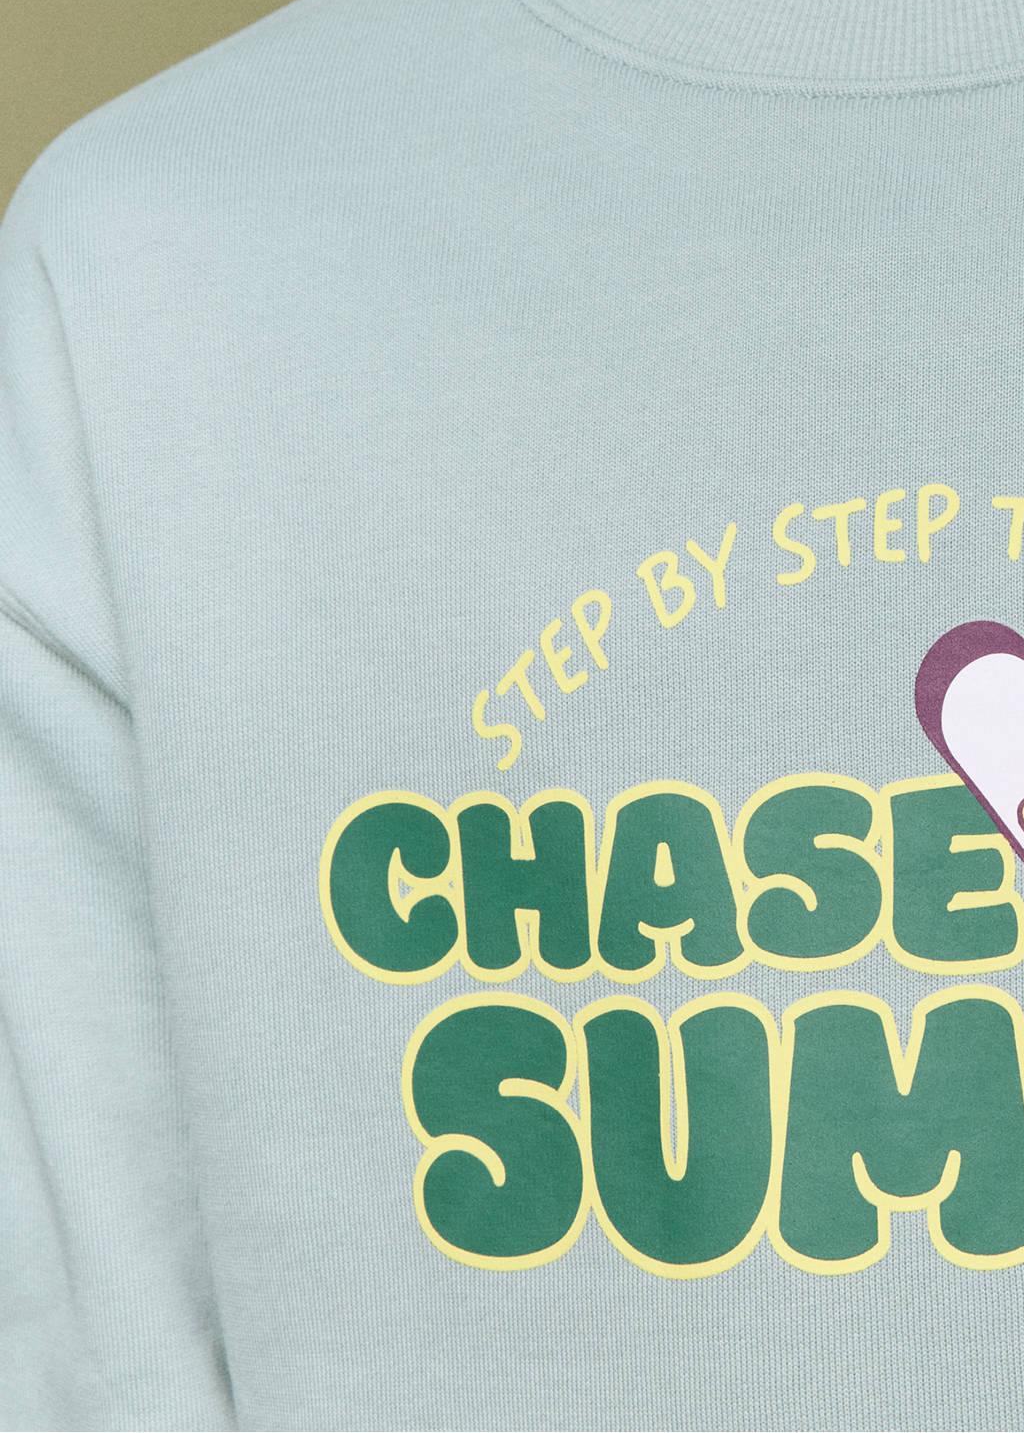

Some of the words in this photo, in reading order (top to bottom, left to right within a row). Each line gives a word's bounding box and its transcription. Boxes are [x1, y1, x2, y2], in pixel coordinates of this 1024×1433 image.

[471, 589, 613, 772] STEP
[636, 522, 738, 629] BY
[771, 483, 961, 586] STEP
